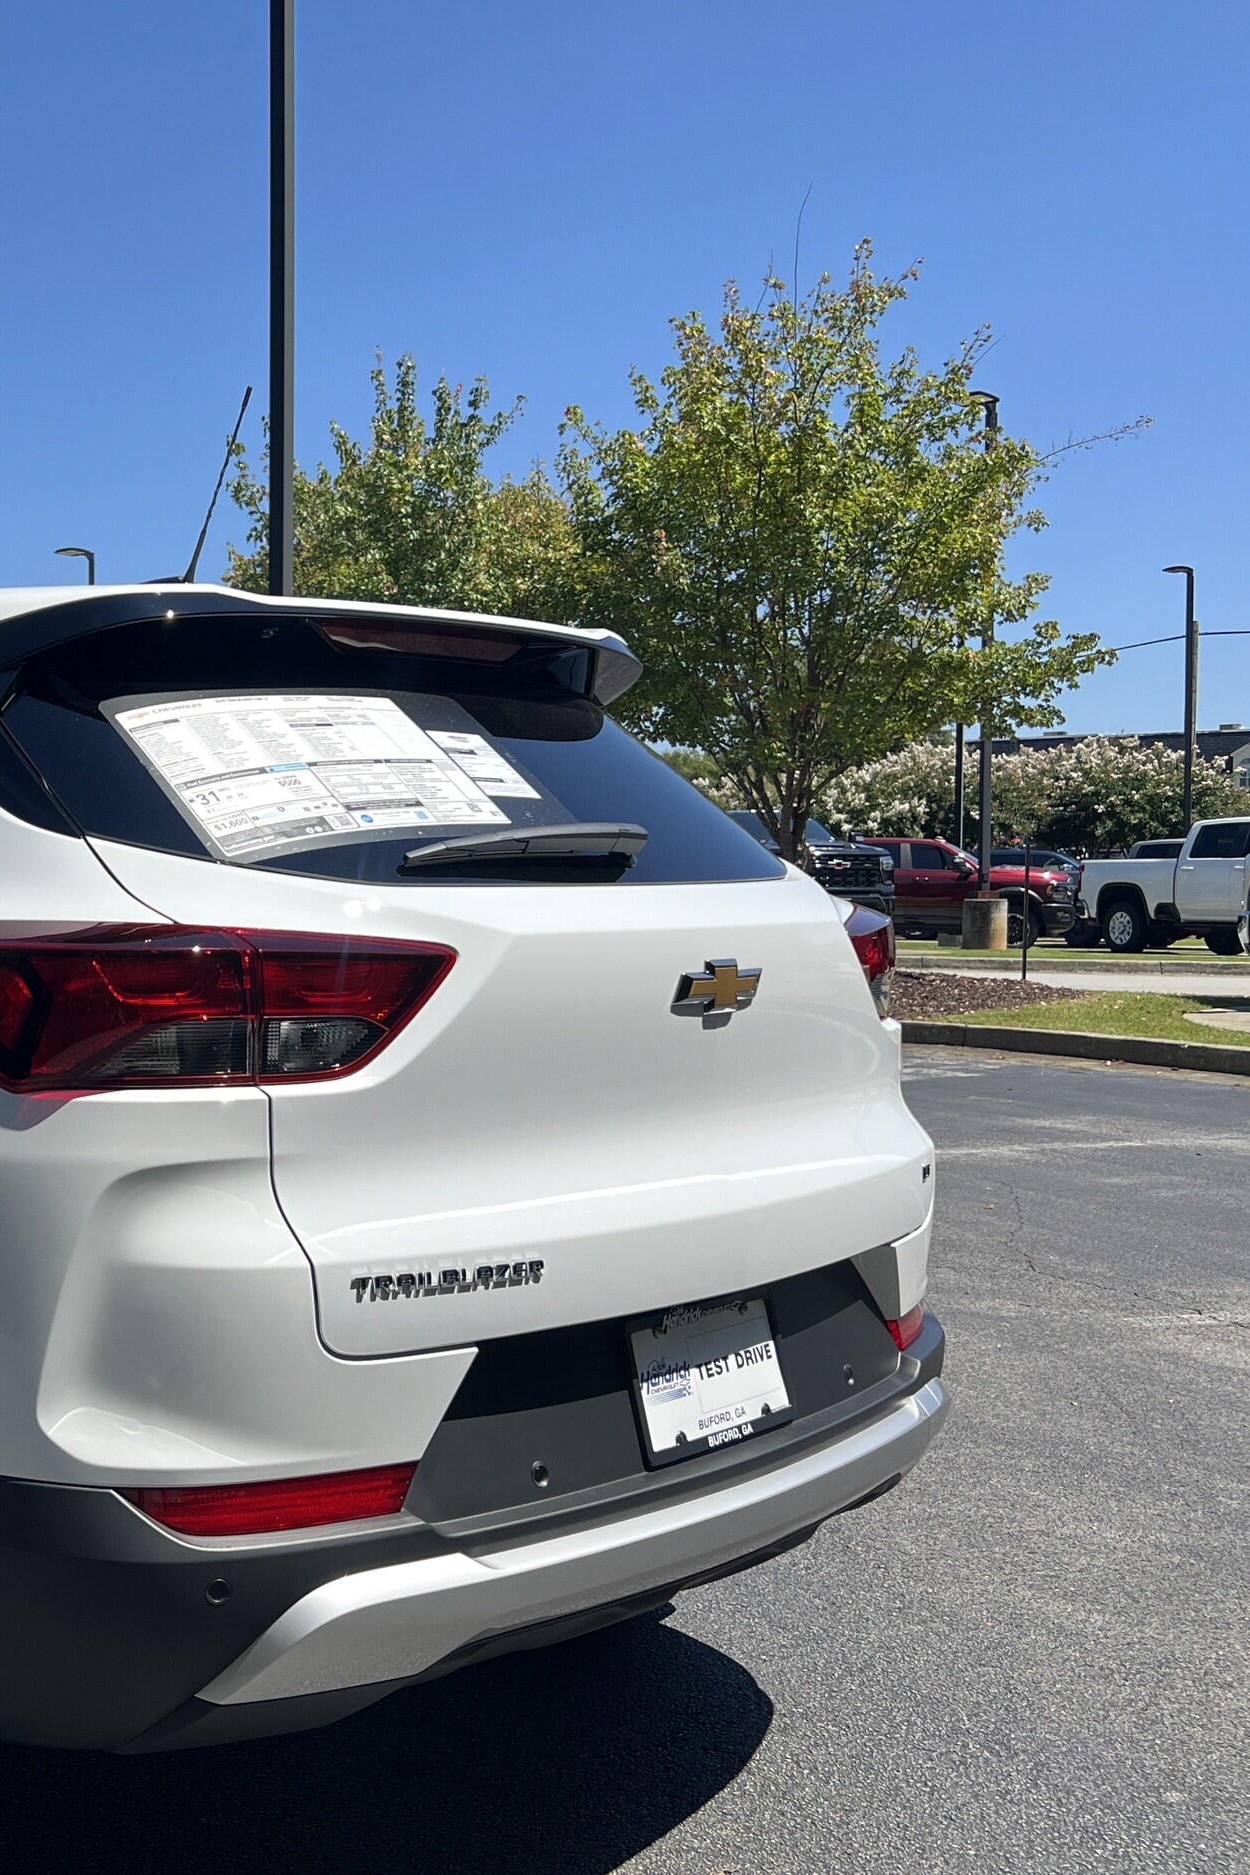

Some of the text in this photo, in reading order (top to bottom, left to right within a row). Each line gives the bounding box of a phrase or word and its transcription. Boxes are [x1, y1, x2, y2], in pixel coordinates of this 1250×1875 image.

[152, 703, 202, 714] CHEVROLET
[278, 779, 301, 787] $500
[196, 790, 221, 806] 31
[214, 817, 248, 831] $1,600
[350, 1260, 544, 1303] TRAILBLAZER
[695, 1343, 772, 1380] TEST DRIVE
[651, 1382, 679, 1394] CHEVROLET
[698, 1406, 746, 1430] BUFORD, GA
[708, 1423, 753, 1447] BUFORD, GA
